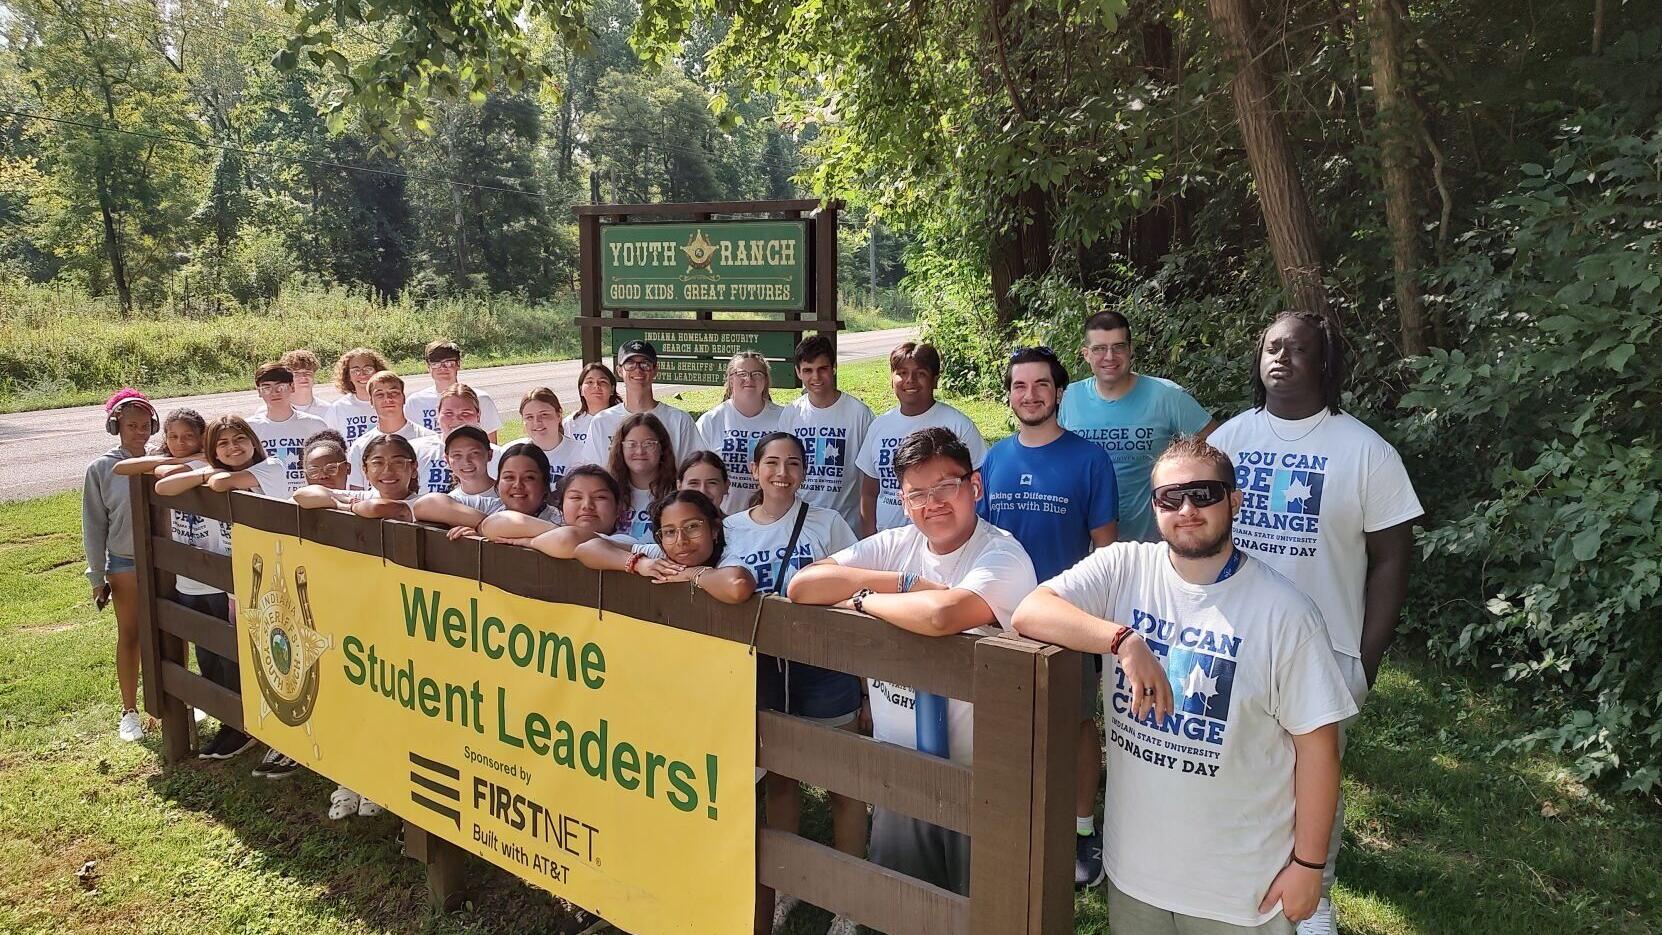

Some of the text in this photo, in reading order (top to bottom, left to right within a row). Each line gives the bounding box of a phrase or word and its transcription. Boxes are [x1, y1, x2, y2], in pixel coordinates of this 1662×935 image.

[609, 239, 796, 267] YOUTH RANCH
[610, 284, 641, 300] GOOD
[683, 284, 726, 301] GREAT
[644, 331, 759, 344] INDIANA HOMELAND SECURITY
[662, 343, 741, 354] SEARCH AND RESCUE
[674, 372, 720, 384] LEADERSHIP
[346, 415, 367, 425] YOU
[794, 426, 847, 438] YOU CAN
[1135, 427, 1154, 439] OF
[279, 438, 305, 447] CAN
[722, 438, 748, 453] BE
[721, 452, 748, 464] THE
[1238, 450, 1329, 471] YOU CAN
[806, 465, 844, 478] ANGE
[1234, 465, 1274, 493] BE
[826, 485, 842, 493] DAY
[991, 490, 1013, 501] aking
[1023, 491, 1069, 504] Difference
[991, 500, 1067, 515] egins with Blue
[1241, 491, 1270, 511] HE
[1253, 531, 1275, 540] STATE
[1275, 535, 1318, 544] UNIVERSITY
[1233, 537, 1317, 557] ONAGHY DAY
[261, 592, 296, 617] INDIANA
[399, 582, 607, 690] Welcome
[1131, 608, 1175, 641] YOU
[1180, 626, 1243, 658] CAN
[263, 646, 284, 691] YOUTH
[342, 635, 485, 734] Student
[497, 686, 719, 821] Leaders!
[1111, 716, 1222, 760] INDIANA STATE UNIVERSITY
[1110, 729, 1221, 778] DONAGHY DAY
[464, 745, 532, 786] Sponsored by
[472, 823, 570, 885] Built with AT&T
